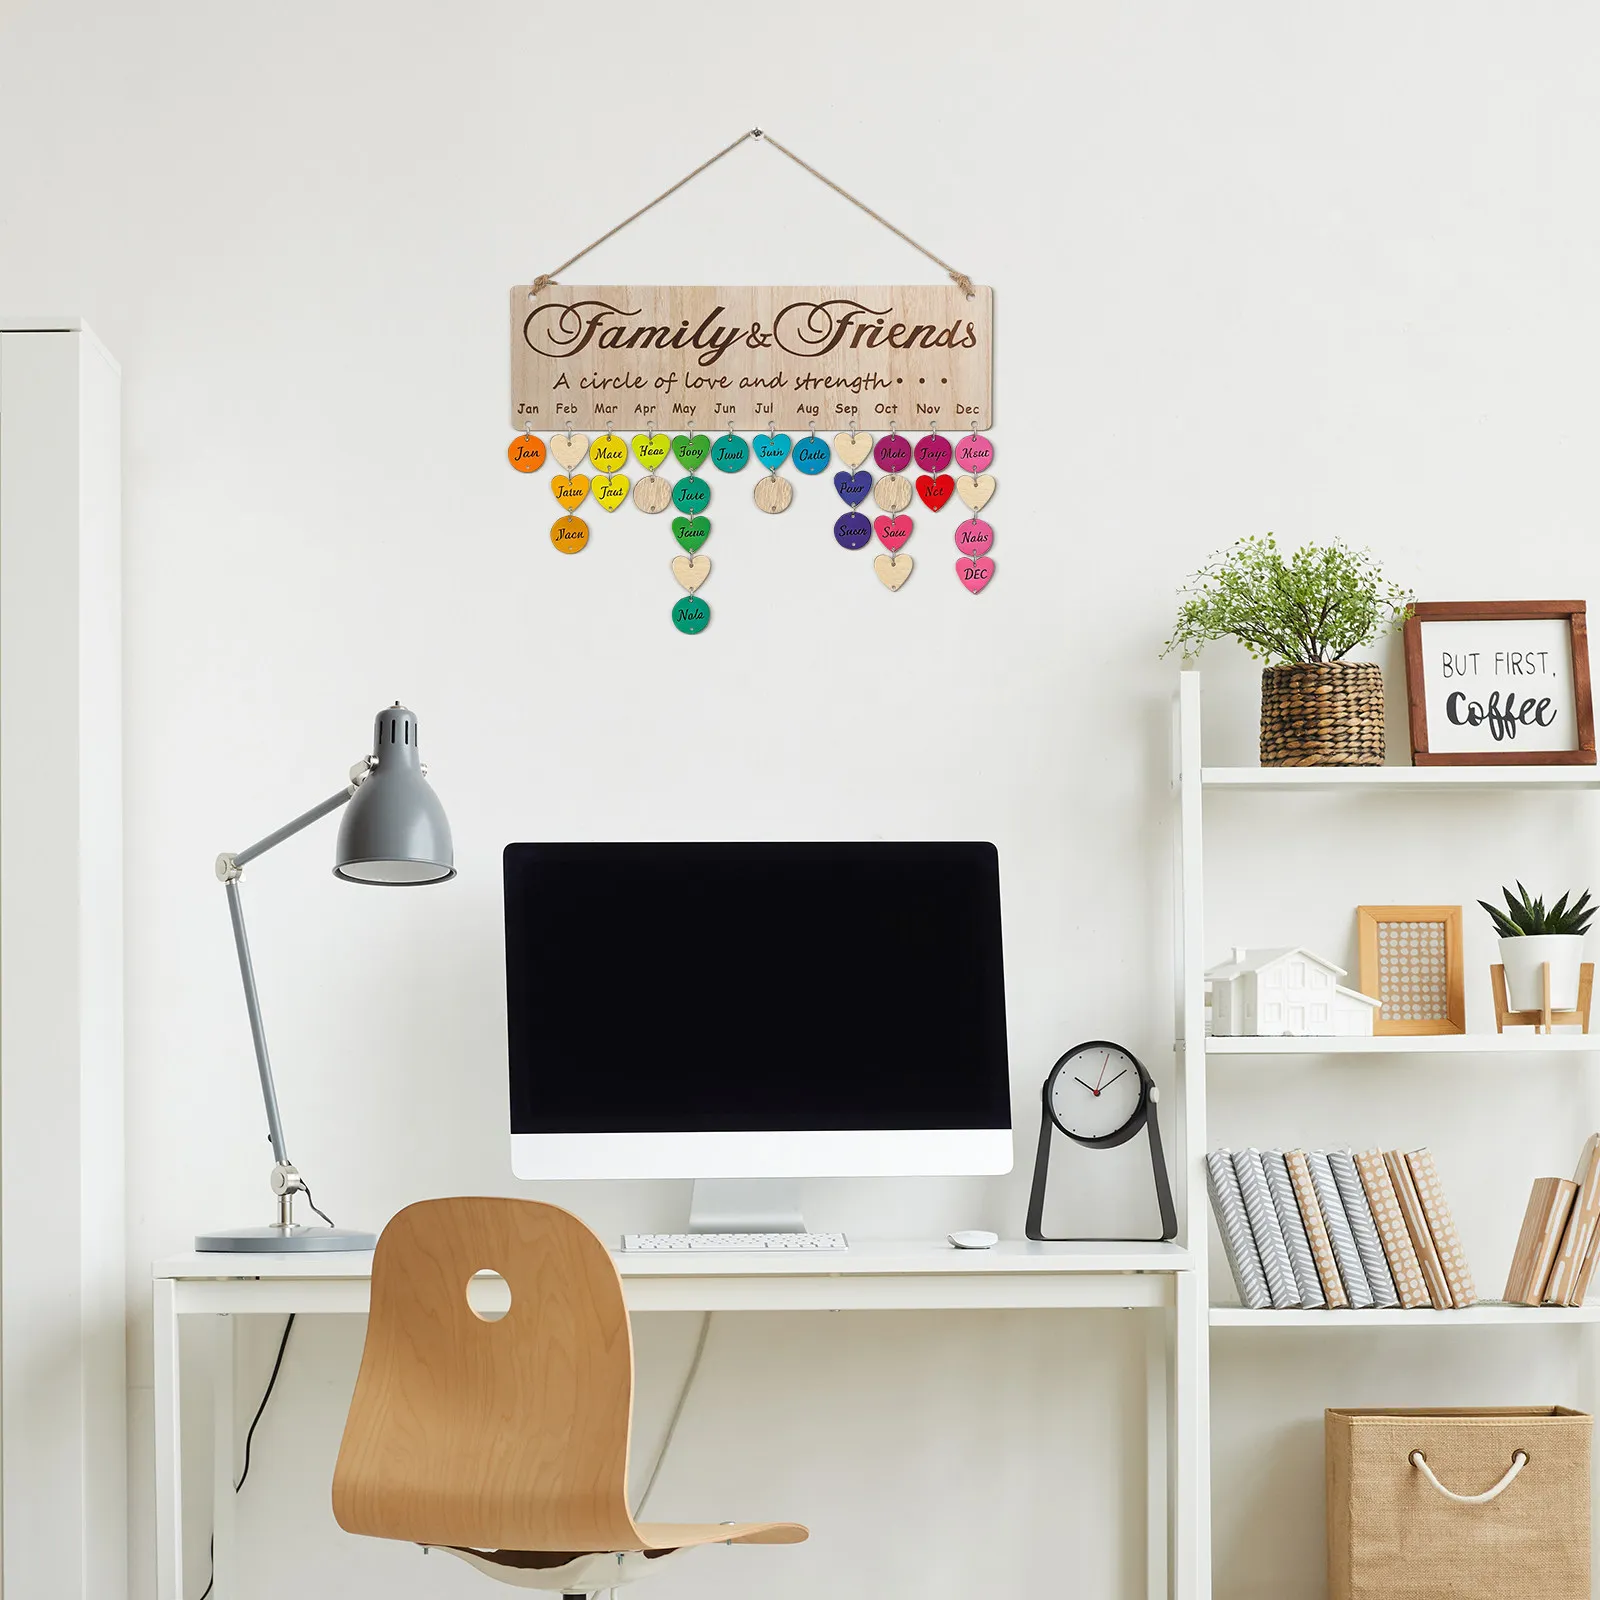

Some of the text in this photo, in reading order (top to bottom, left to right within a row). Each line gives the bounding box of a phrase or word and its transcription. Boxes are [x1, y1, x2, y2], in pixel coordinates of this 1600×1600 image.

[523, 300, 749, 366] Family
[773, 300, 977, 357] Friends
[553, 373, 570, 390] A
[579, 372, 648, 390] circle
[654, 372, 678, 394] of
[685, 371, 733, 389] love
[739, 371, 788, 389] and
[517, 403, 539, 414] Jan
[555, 403, 578, 414] Feb
[594, 404, 618, 414] Mar
[634, 404, 656, 416] Apr
[672, 404, 697, 416] May
[714, 403, 736, 414] Jun
[754, 403, 774, 414] Jul
[796, 404, 820, 416] Aug
[835, 403, 858, 416] Sep
[874, 403, 898, 414] Oct
[916, 404, 941, 414] Nov
[956, 403, 980, 414] Dec
[963, 567, 989, 581] DEC
[1442, 652, 1480, 678] BUT
[1446, 691, 1557, 741] Coffee
